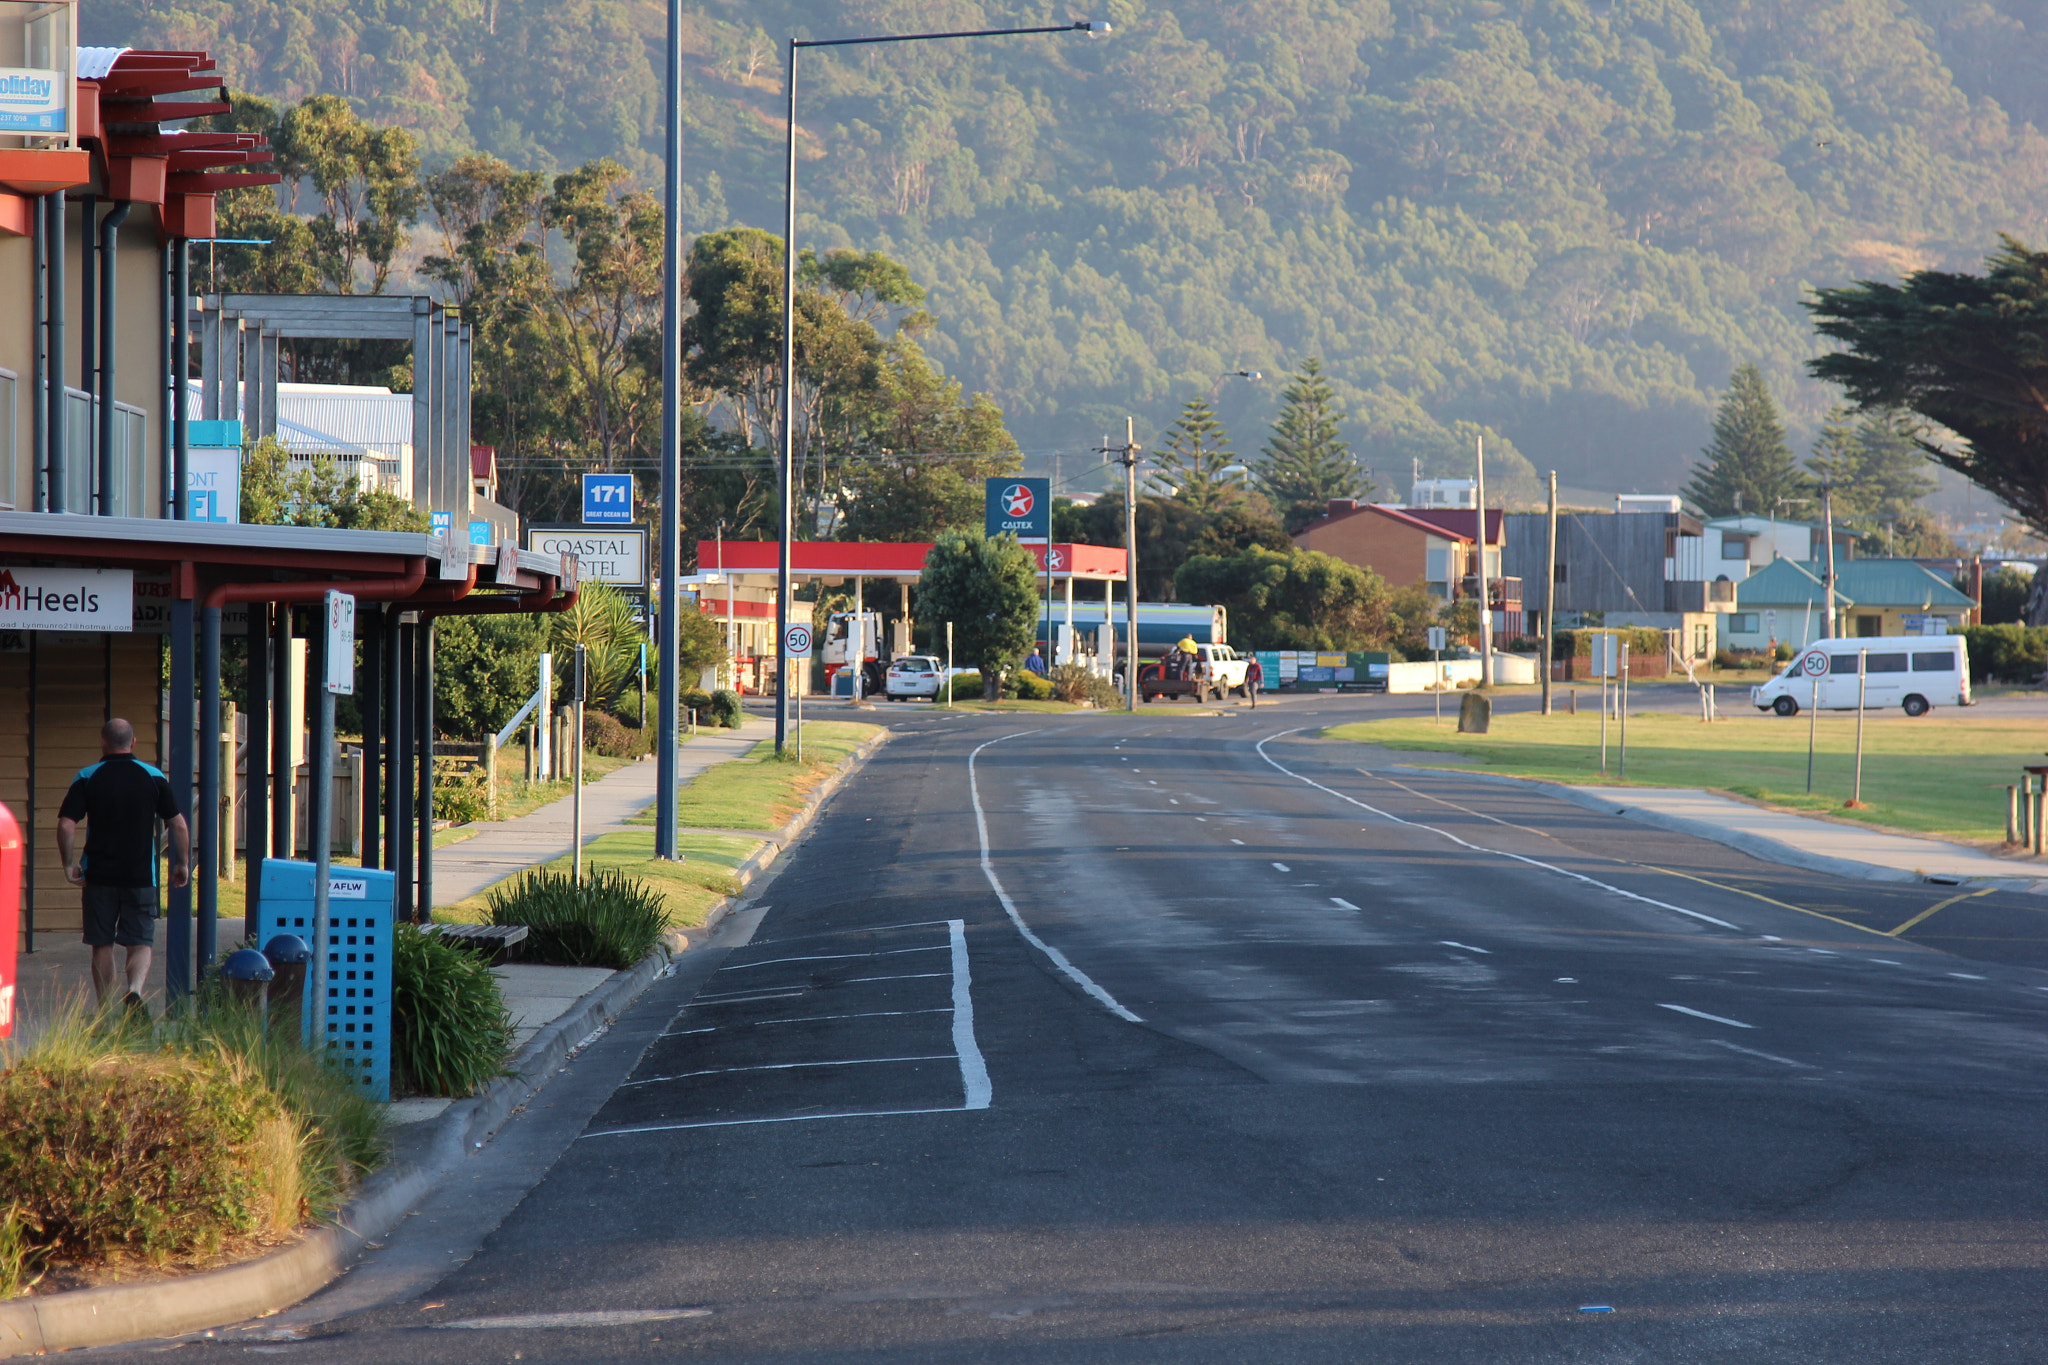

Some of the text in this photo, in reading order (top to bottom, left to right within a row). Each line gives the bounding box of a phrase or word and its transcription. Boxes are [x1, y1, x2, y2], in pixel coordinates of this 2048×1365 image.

[590, 485, 626, 503] 171
[1001, 521, 1033, 530] CALTEX
[542, 539, 631, 556] COASTAL
[789, 633, 807, 647] 50
[1807, 656, 1825, 670] 50
[333, 882, 362, 891] AFLW
